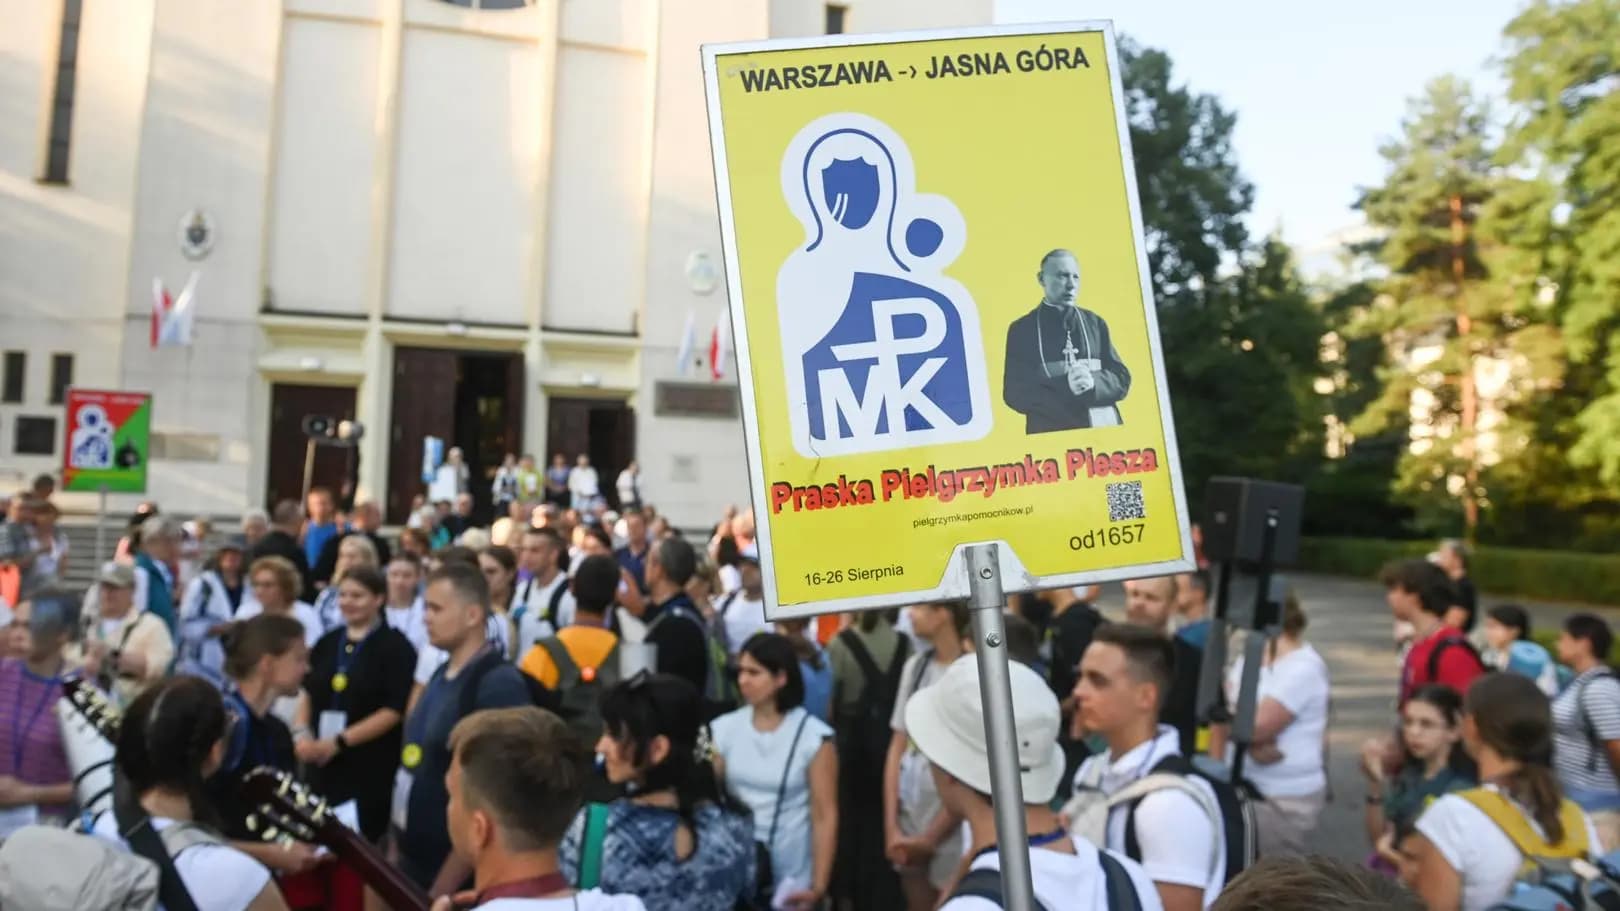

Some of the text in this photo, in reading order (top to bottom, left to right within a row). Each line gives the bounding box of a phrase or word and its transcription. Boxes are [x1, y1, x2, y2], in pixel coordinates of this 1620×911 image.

[740, 44, 1090, 94] WARSZAWA JASNA GÓRA
[771, 447, 1159, 514] Praska Pielgrzymka Piesza
[912, 505, 1034, 529] pielgrzymkapomocnikow.pl
[1069, 523, 1146, 551] od1657
[804, 564, 905, 586] 16-26 Sierpnia
